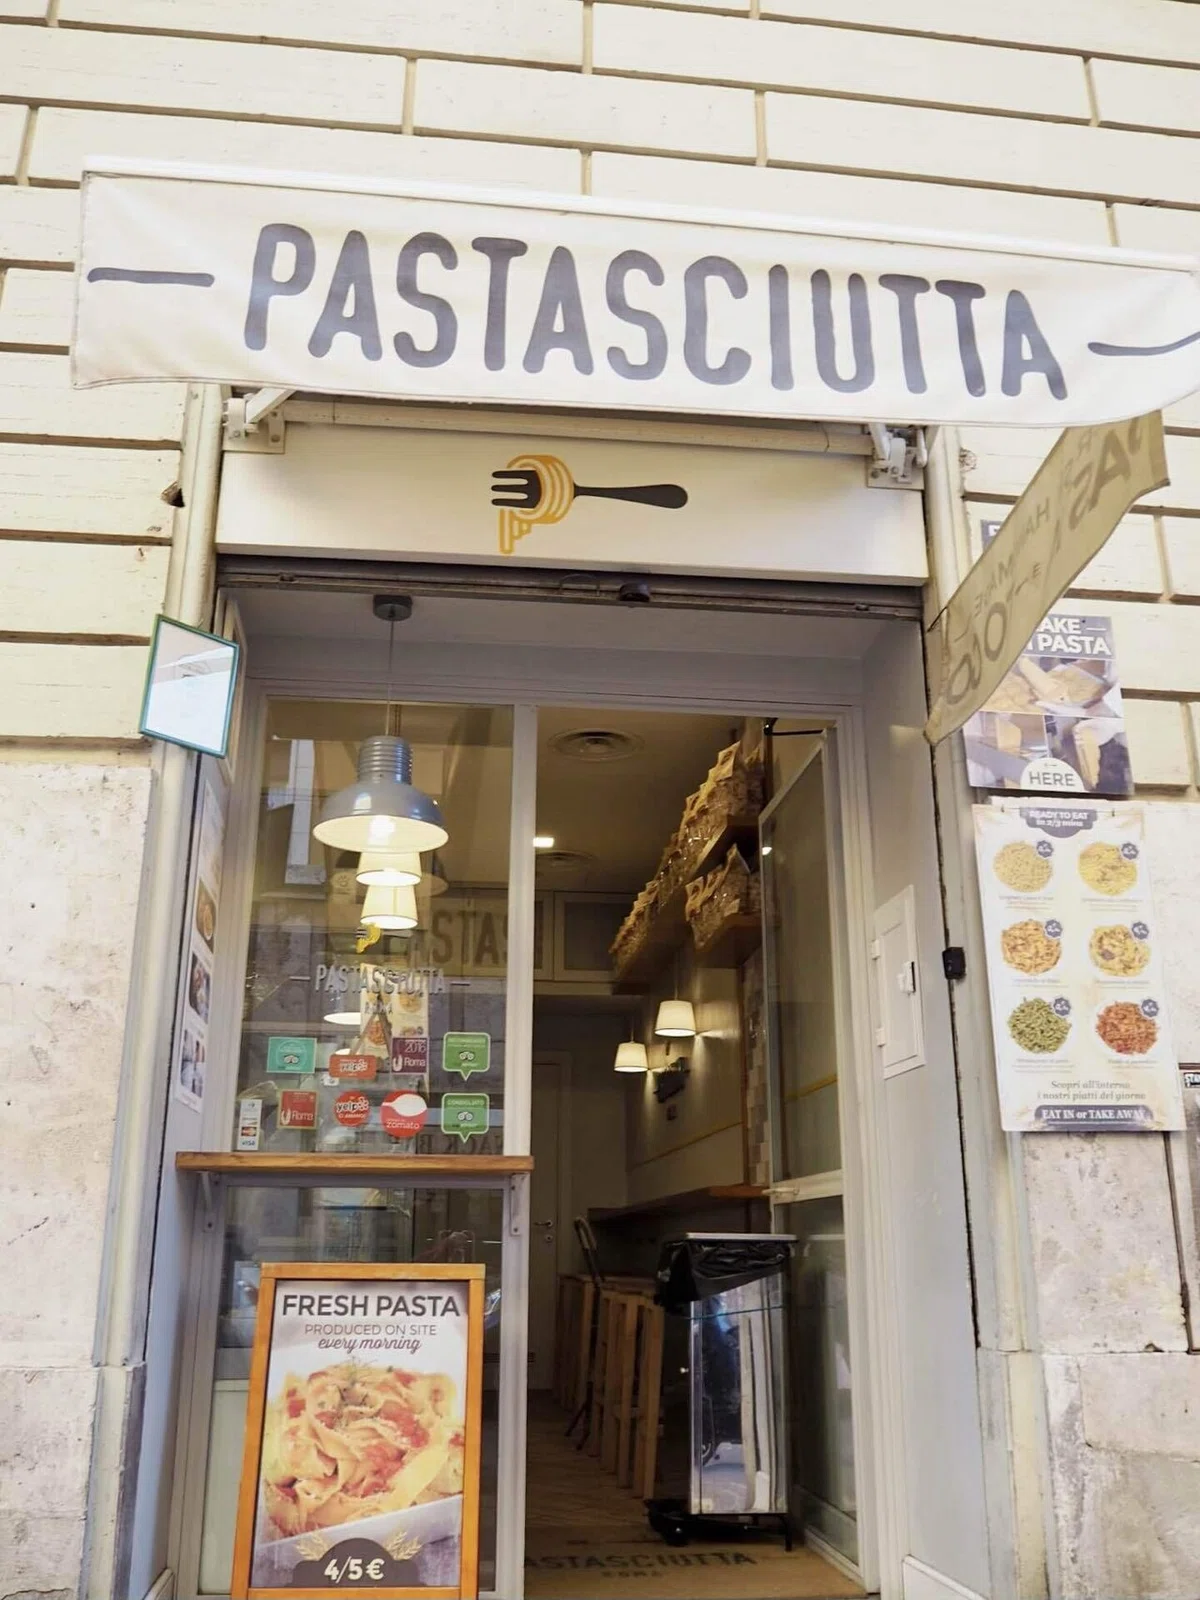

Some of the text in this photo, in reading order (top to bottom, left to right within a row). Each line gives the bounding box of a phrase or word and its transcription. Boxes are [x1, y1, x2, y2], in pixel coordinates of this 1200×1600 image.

[244, 223, 1067, 400] PASTASCIUTTA
[1037, 616, 1082, 635] AKE
[1037, 633, 1112, 656] PASTA
[1029, 771, 1075, 786] HERE
[1057, 811, 1071, 820] TO
[1072, 812, 1089, 820] EAT
[404, 1057, 426, 1067] Roma
[1043, 1091, 1071, 1100] nostri
[1042, 1109, 1061, 1119] EAT
[1063, 1110, 1075, 1119] IN
[1088, 1110, 1114, 1119] TAKE
[1116, 1110, 1145, 1119] AWAY
[386, 1120, 420, 1130] zomato
[282, 1294, 461, 1317] FRESH PASTA
[305, 1324, 437, 1336] PRODUCED ON SITE
[318, 1336, 422, 1355] every morning
[524, 1552, 758, 1569] ASTASCIUTTA
